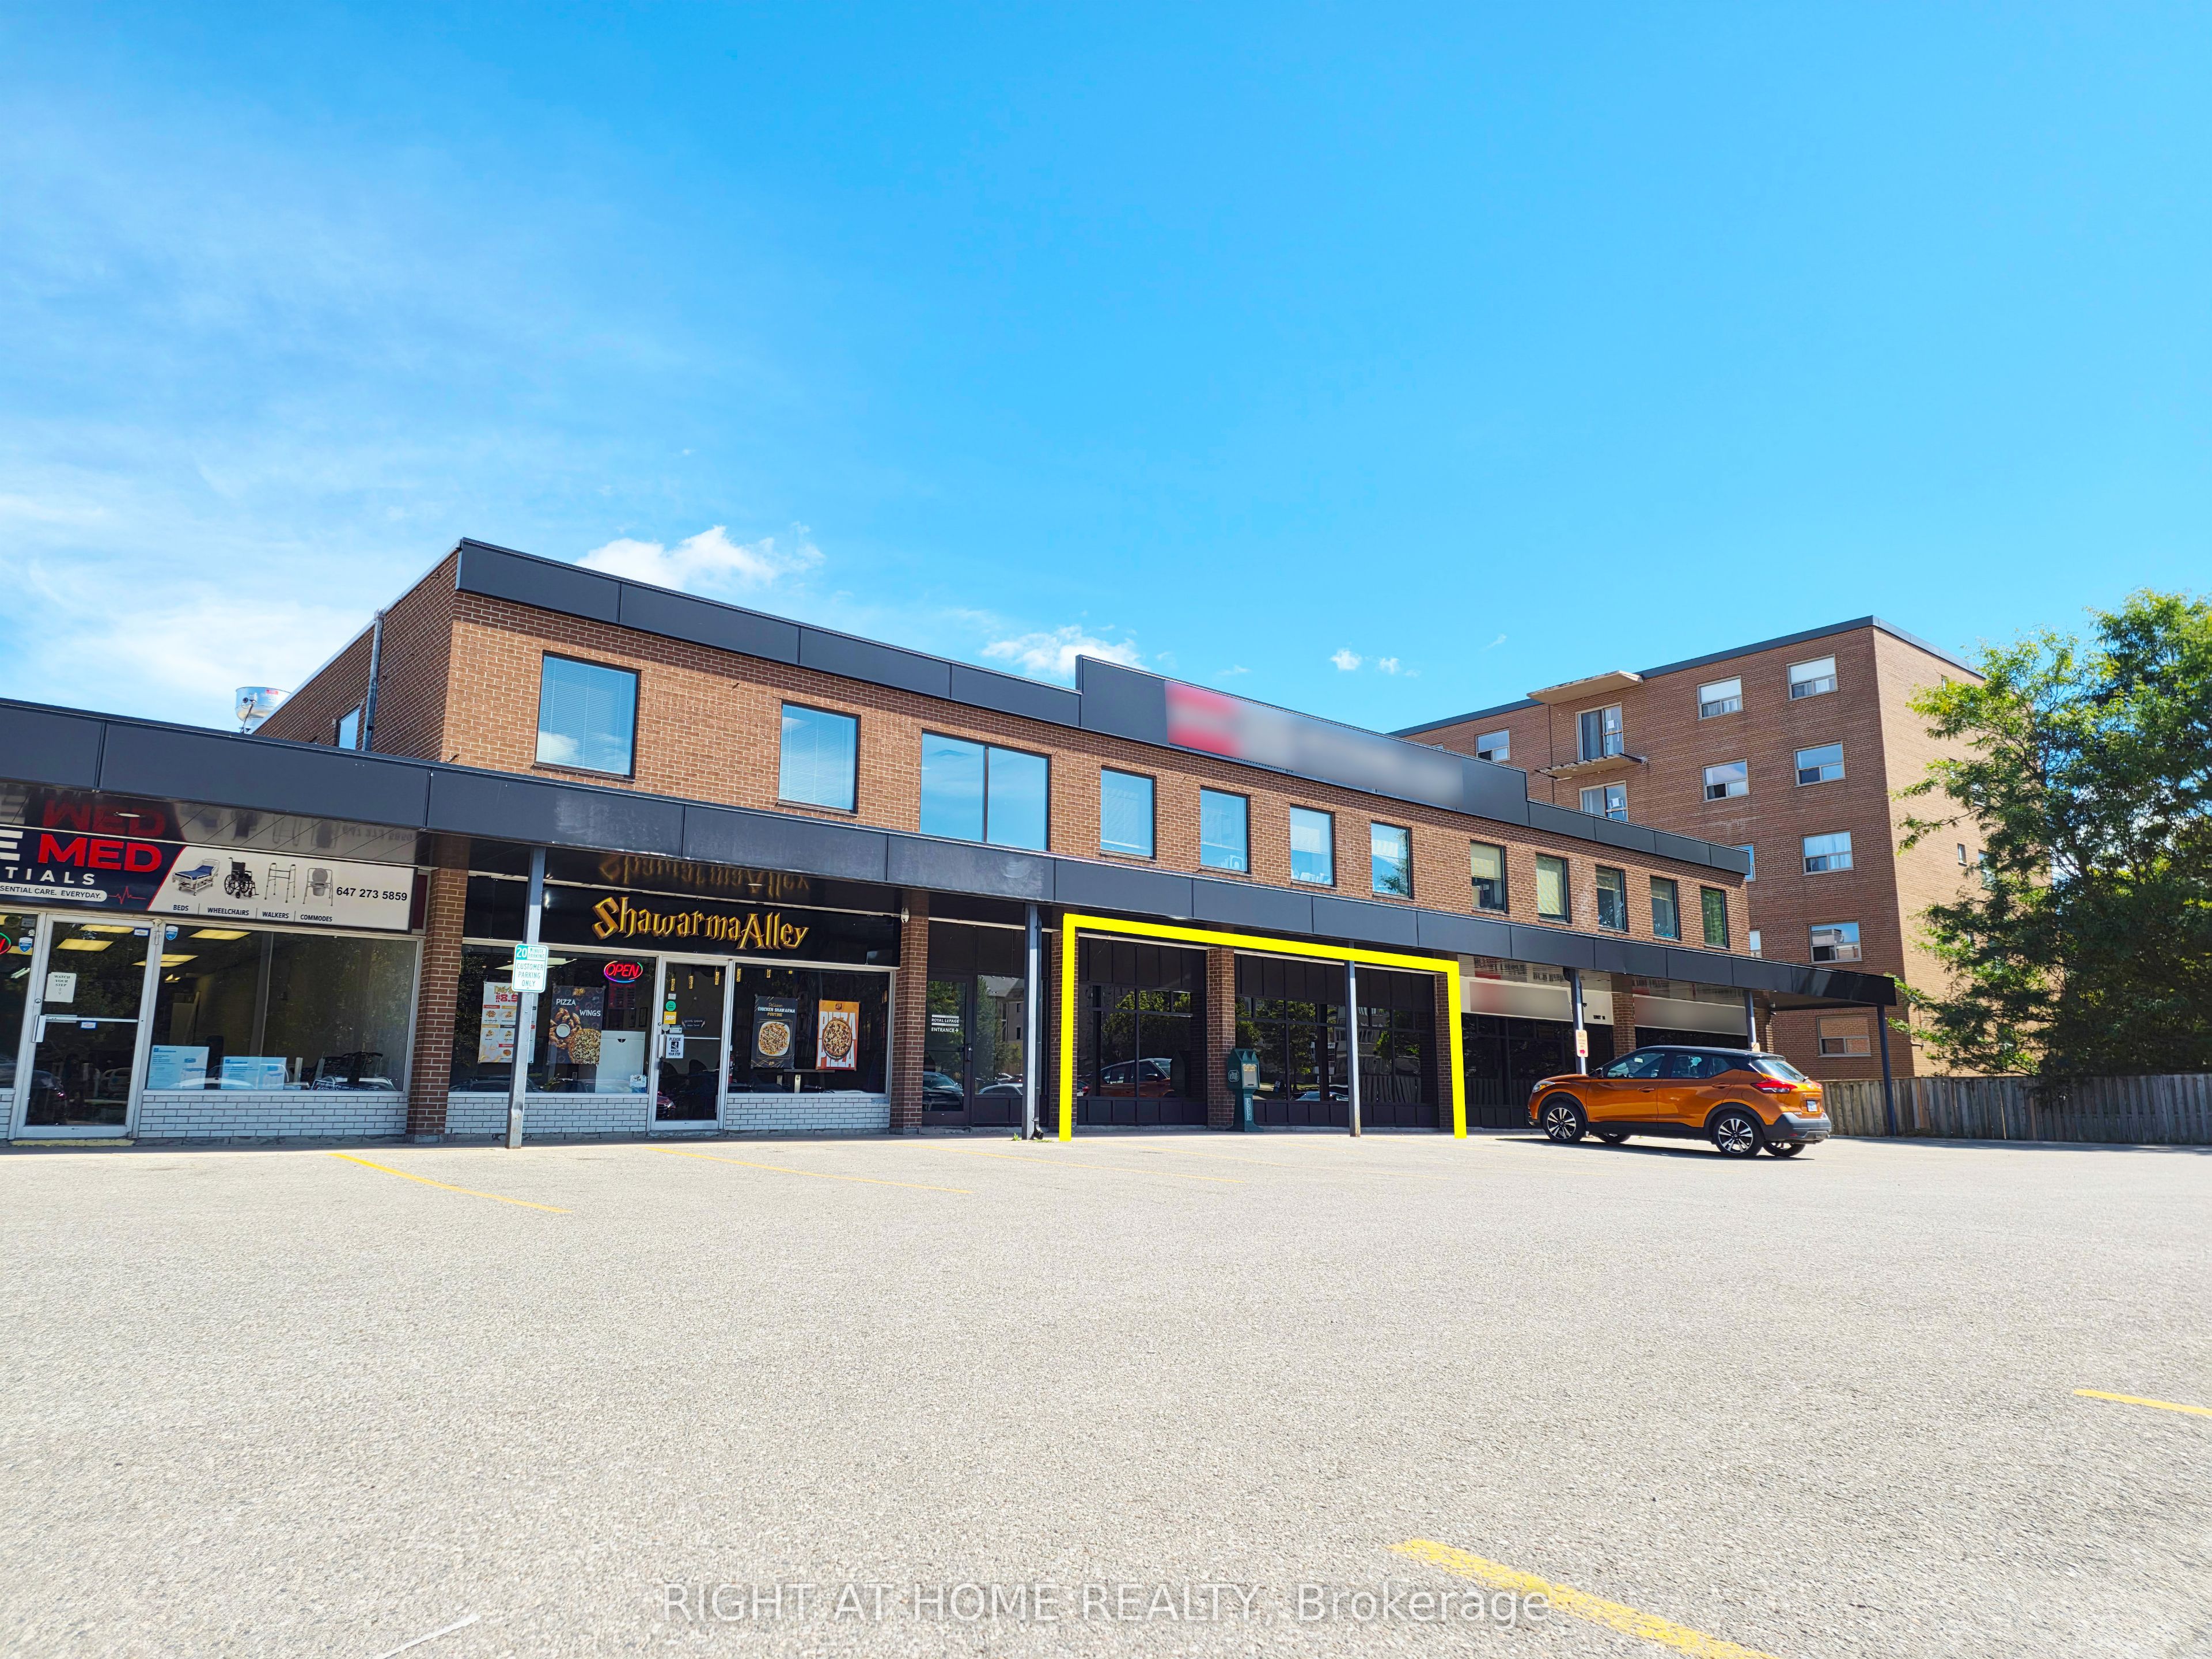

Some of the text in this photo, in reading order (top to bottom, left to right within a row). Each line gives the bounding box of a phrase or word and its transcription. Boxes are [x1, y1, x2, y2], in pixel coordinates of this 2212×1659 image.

[38, 834, 162, 873] MED
[5, 866, 96, 885] TIALS
[60, 890, 101, 899] EVERYDAY.
[336, 886, 408, 902] 647 273 5859
[173, 904, 189, 912] BEDS
[207, 907, 249, 916] WHEELCHAIRS
[262, 911, 289, 919] WALKERS
[300, 914, 333, 922] COMMODES
[517, 947, 528, 958] 20
[517, 963, 544, 971] CUSTOMER
[605, 964, 640, 977] OPEN
[518, 971, 541, 979] PARKING
